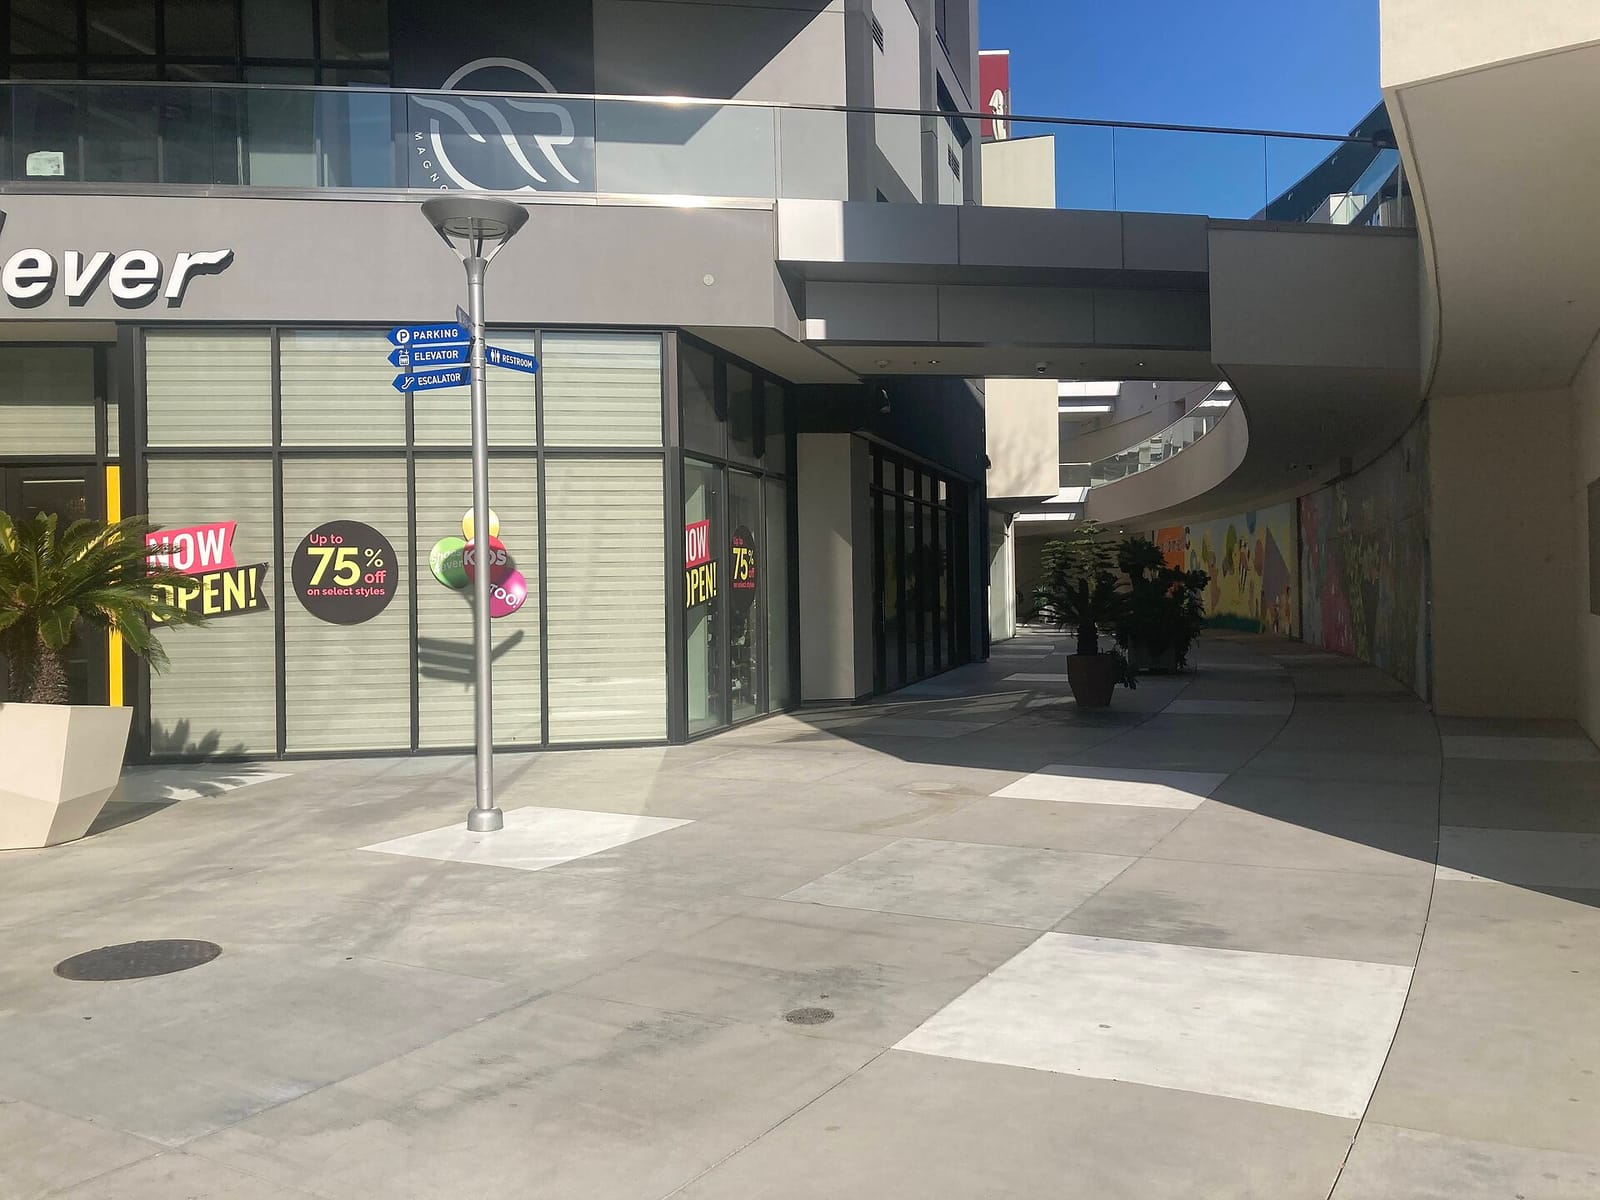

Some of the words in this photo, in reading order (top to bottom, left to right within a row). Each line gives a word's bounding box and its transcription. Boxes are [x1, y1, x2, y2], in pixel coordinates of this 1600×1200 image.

[0, 247, 234, 309] ever
[413, 328, 458, 340] PARKING
[414, 350, 459, 361] ELEVATOR
[502, 354, 533, 369] RESTROOM
[417, 373, 461, 386] ESCALATOR
[309, 533, 327, 546] Up
[330, 533, 343, 544] to
[148, 527, 226, 570] NOW
[364, 570, 387, 584] off
[307, 587, 320, 596] on
[322, 586, 353, 596] select
[355, 586, 385, 598] styles
[490, 583, 521, 609] TOO!
